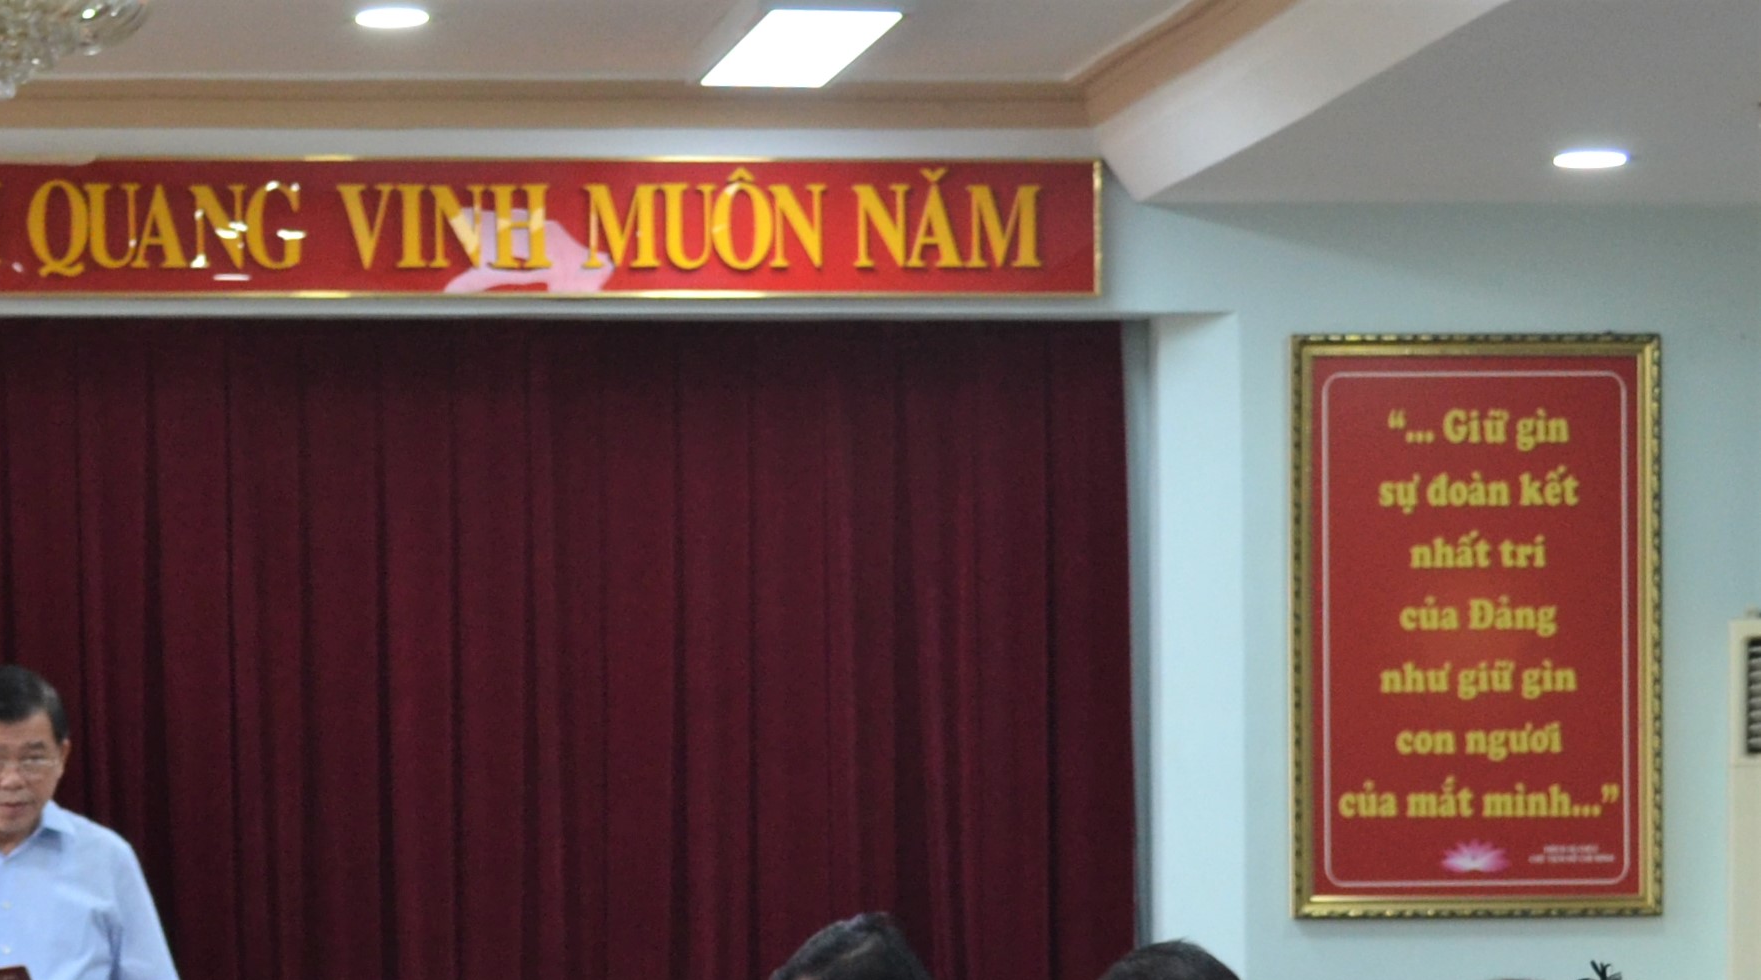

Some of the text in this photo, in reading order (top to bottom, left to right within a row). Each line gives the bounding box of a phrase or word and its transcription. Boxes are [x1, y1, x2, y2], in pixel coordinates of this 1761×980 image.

[27, 180, 304, 278] QUANG
[337, 183, 553, 270] VINH
[582, 168, 826, 270] MUÔN
[853, 168, 1042, 269] NĂM
[1443, 408, 1509, 444] Giữ
[1379, 477, 1419, 514] sự
[1520, 466, 1578, 506] kết
[1411, 530, 1491, 569] nhất
[1381, 661, 1452, 694] như
[1458, 658, 1515, 700] giữ
[1396, 729, 1457, 755] con
